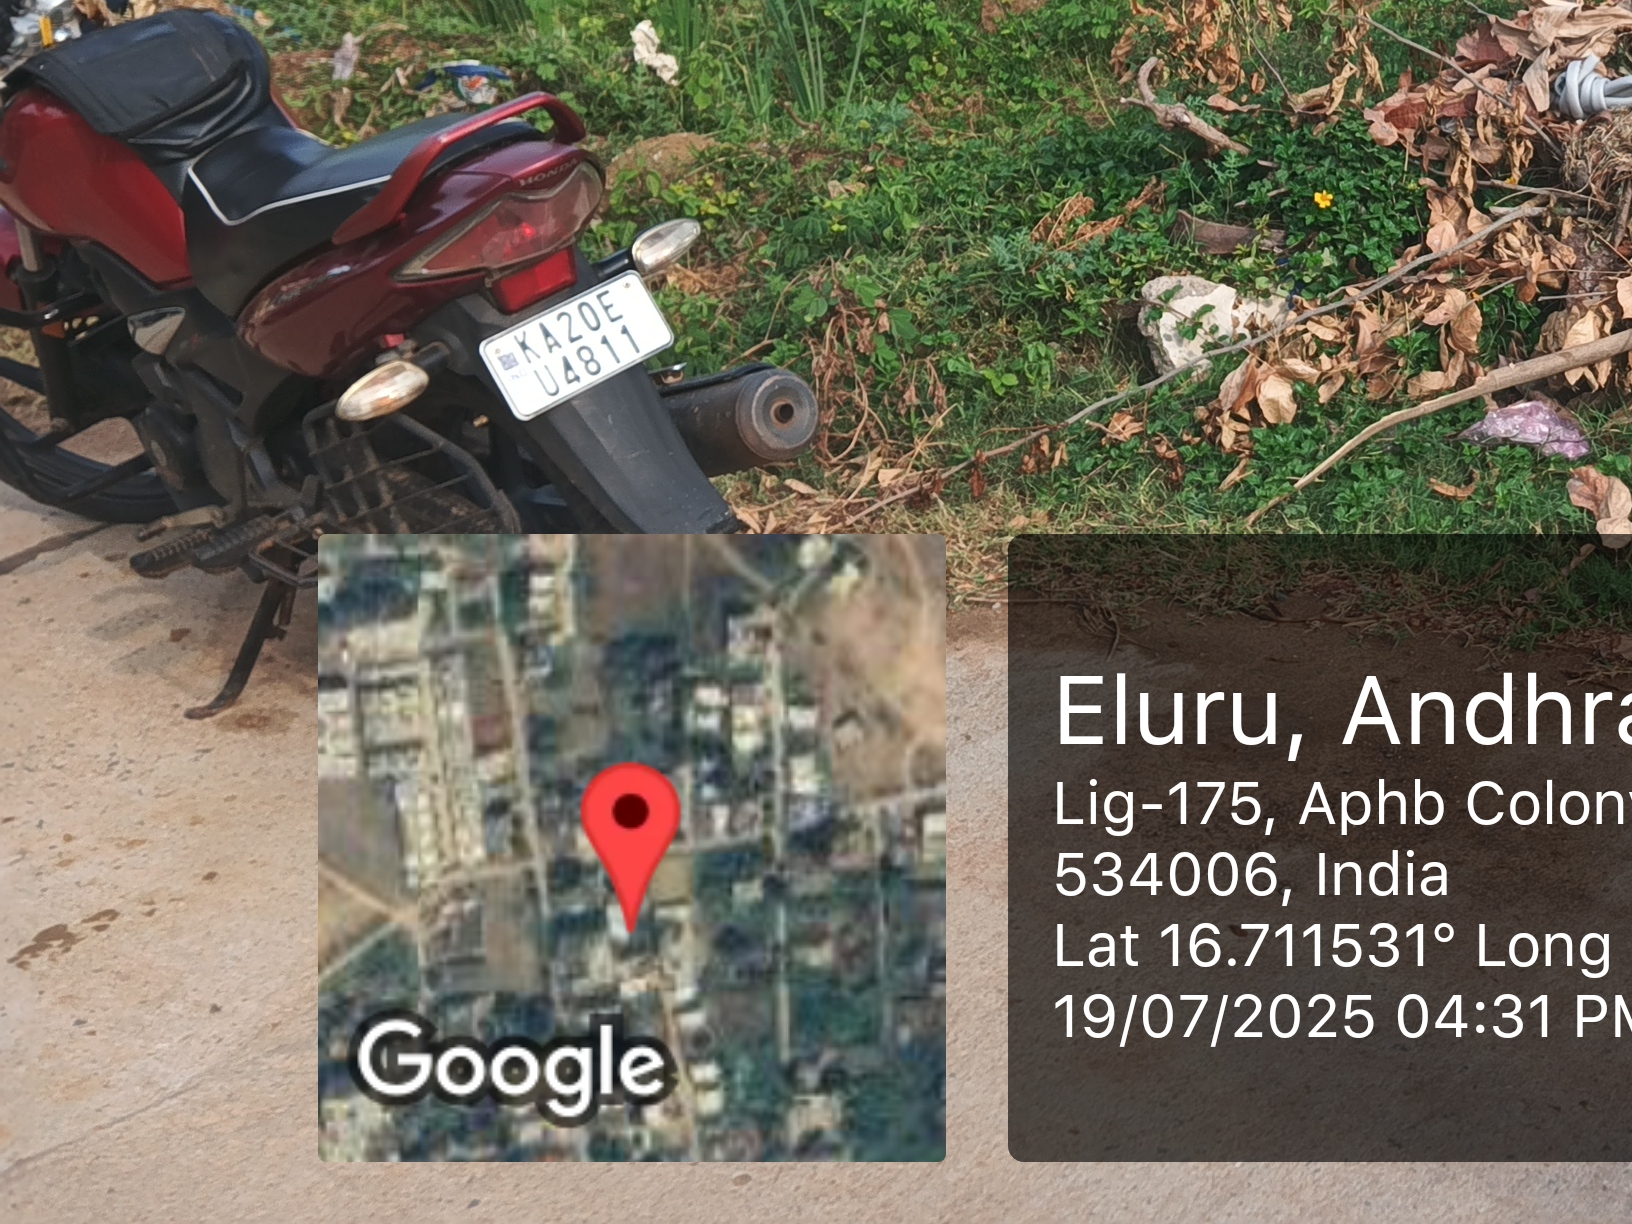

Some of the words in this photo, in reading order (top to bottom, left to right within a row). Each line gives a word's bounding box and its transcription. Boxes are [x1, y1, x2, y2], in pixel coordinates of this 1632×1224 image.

[519, 158, 579, 187] HONDA
[513, 289, 624, 364] KA20E
[533, 324, 641, 397] U4811
